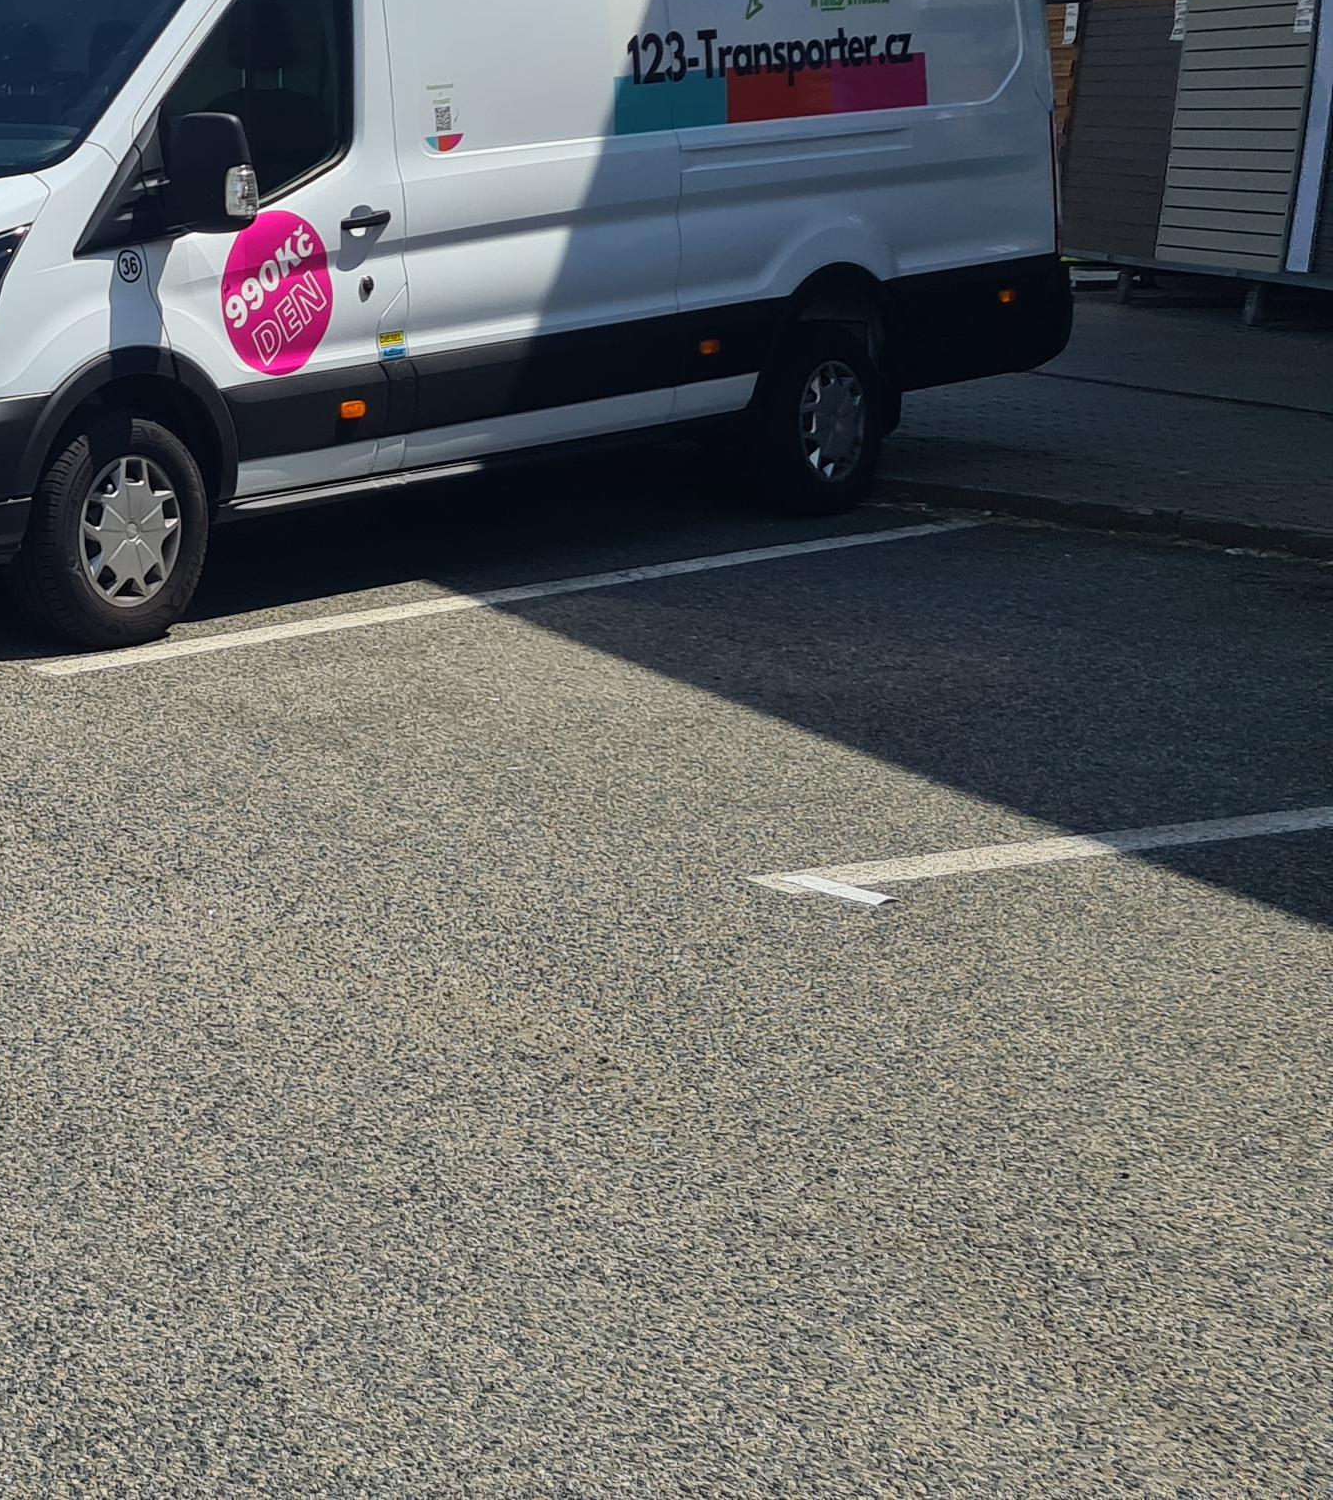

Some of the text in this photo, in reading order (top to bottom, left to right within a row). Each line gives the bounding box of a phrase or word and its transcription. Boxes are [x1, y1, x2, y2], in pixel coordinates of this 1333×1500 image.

[627, 27, 914, 87] 123-Transporter.cz
[121, 257, 137, 276] 36
[251, 270, 327, 366] DEN
